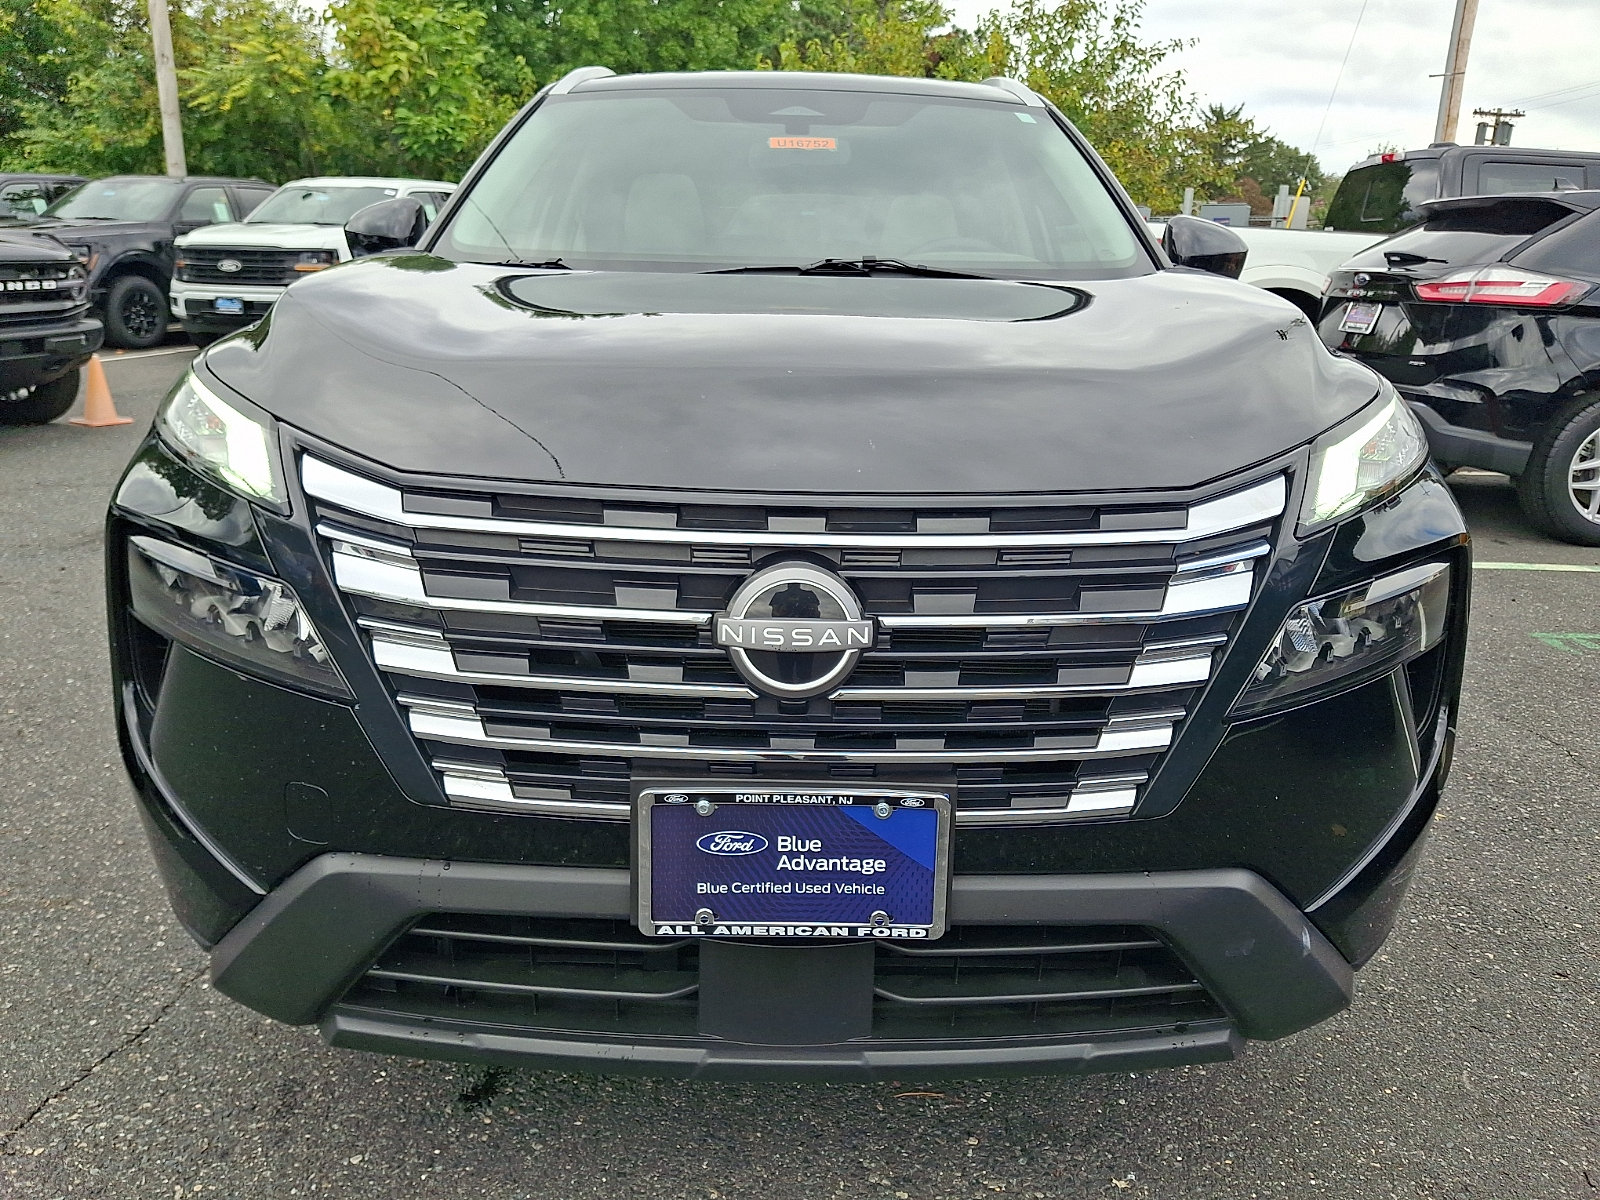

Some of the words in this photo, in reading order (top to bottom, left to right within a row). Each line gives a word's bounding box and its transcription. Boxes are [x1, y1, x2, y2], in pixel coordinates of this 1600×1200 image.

[777, 139, 829, 148] U16752
[721, 624, 869, 646] NISSAN
[736, 794, 769, 803] POINT
[772, 795, 836, 805] PLEASANT,
[839, 796, 854, 805] NJ
[710, 834, 755, 852] Ford
[777, 836, 822, 852] Blue
[777, 855, 886, 875] Advantage
[697, 883, 728, 894] Blue
[732, 882, 790, 894] Certified
[795, 883, 831, 895] Used
[835, 884, 885, 895] Vehicle
[657, 925, 705, 935] ALL
[713, 926, 848, 937] AMERICAN
[858, 928, 927, 938] FORD
